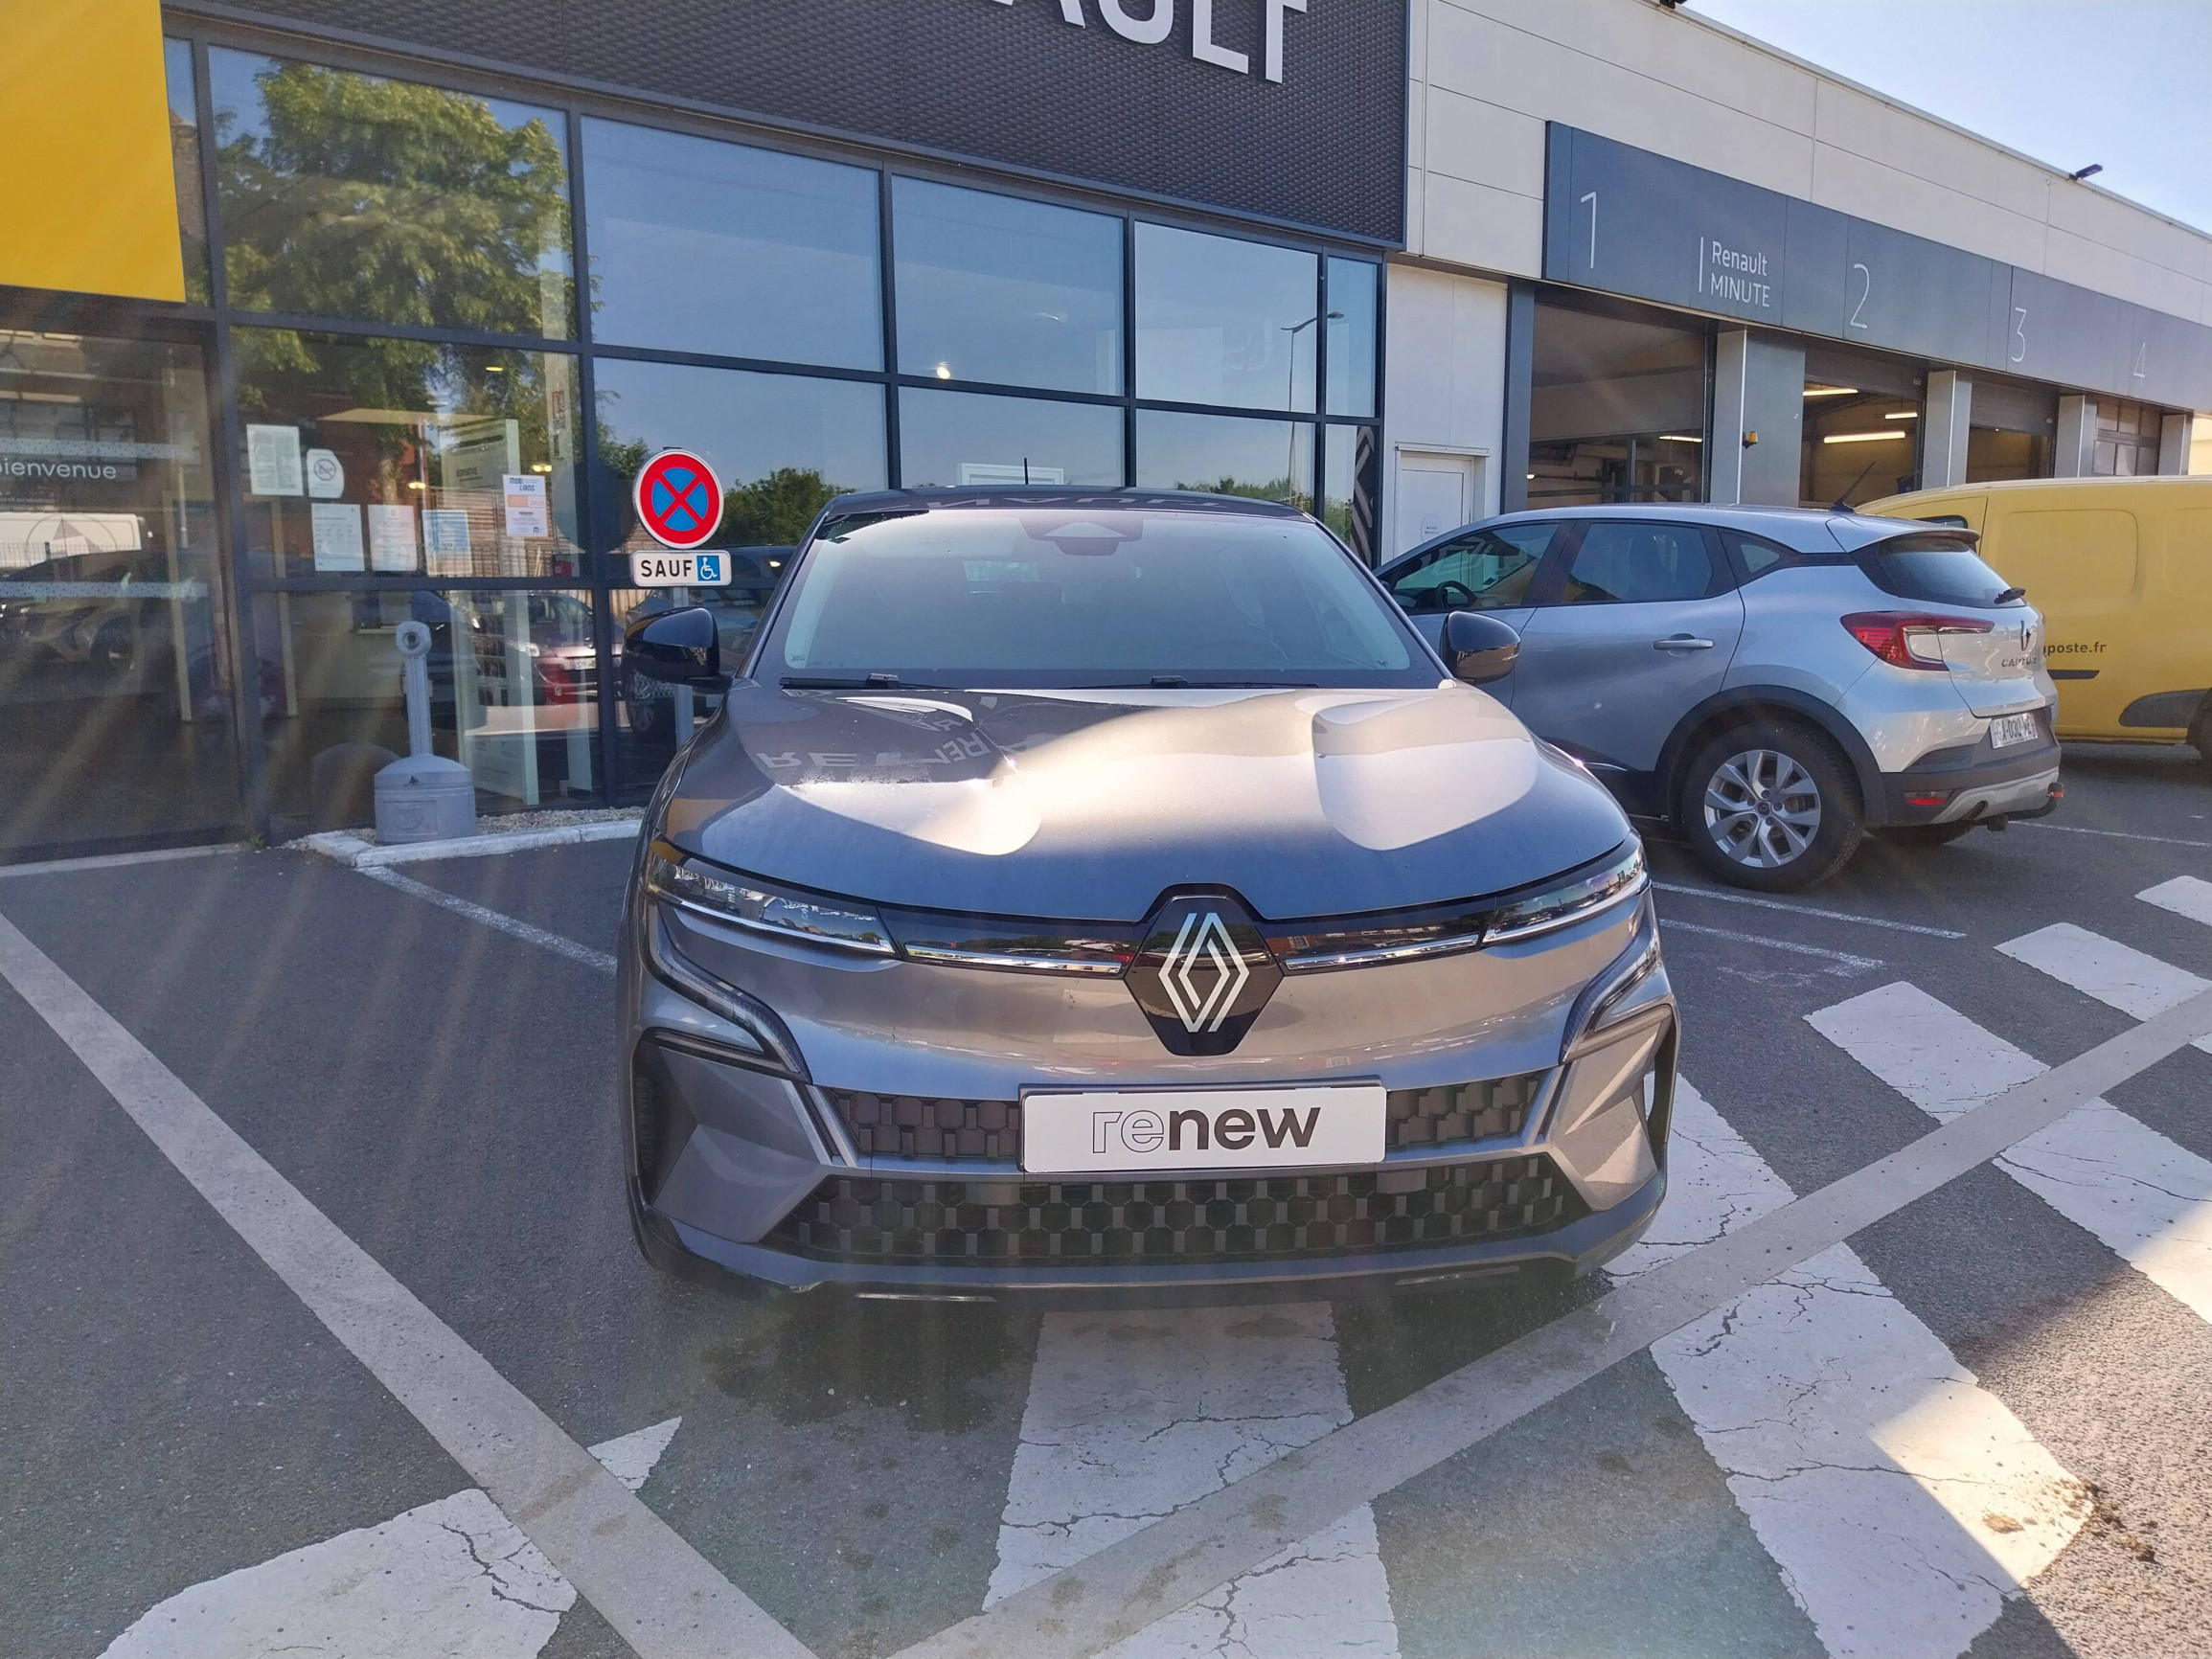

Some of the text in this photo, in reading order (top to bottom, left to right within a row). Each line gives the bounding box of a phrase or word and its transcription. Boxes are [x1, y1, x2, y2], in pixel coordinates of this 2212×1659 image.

[1581, 192, 1597, 269] 1
[1712, 240, 1767, 277] Renault
[1710, 272, 1770, 308] MINUTE
[1850, 263, 1870, 329] 2
[2012, 307, 2027, 363] 3
[2133, 342, 2146, 388] 4
[0, 458, 117, 479] ienvenue
[640, 559, 693, 578] SAUF
[1092, 1106, 1322, 1154] renew
